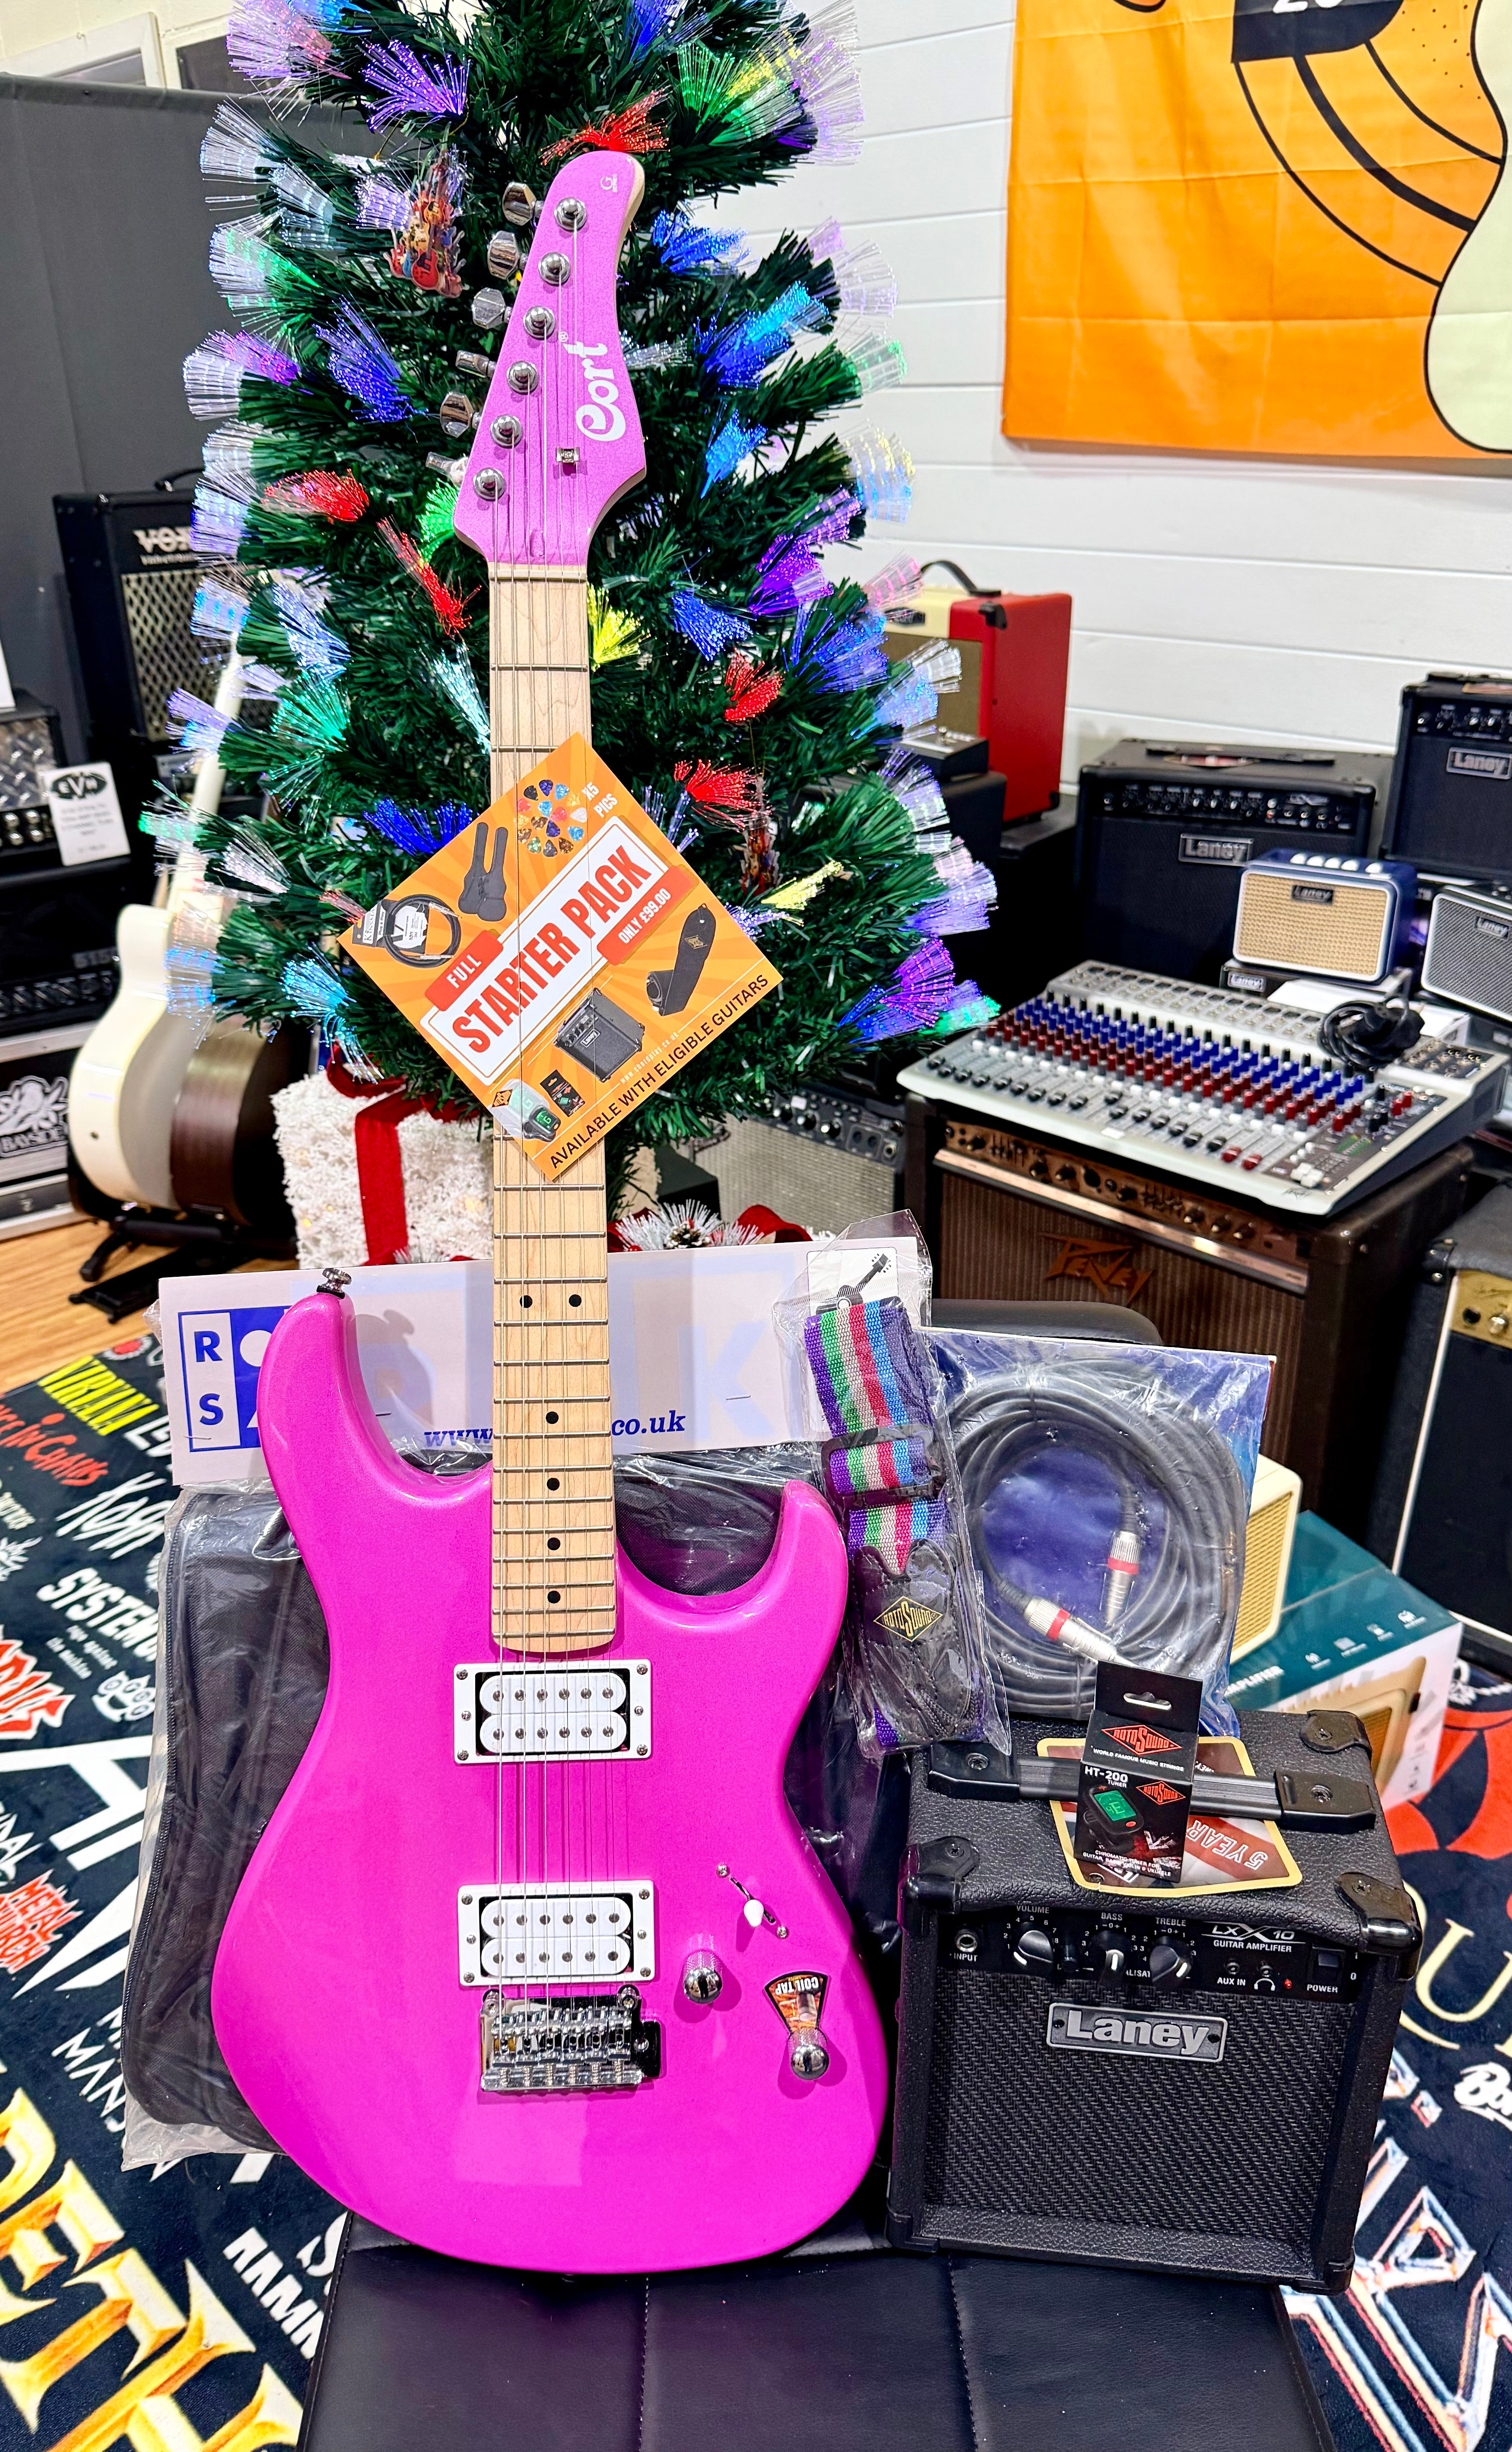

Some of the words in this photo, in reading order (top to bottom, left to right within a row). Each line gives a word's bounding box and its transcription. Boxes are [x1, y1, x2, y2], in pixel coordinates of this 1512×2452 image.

[563, 341, 626, 442] Cort
[593, 793, 618, 818] PICS
[1185, 837, 1246, 863] Laney
[618, 919, 643, 944] ONLY
[638, 888, 671, 924] £99.00
[452, 923, 580, 1053] STARTER
[560, 844, 652, 939] PACK
[446, 954, 482, 989] FULL
[619, 1031, 680, 1084] www.chordplay.co.uk
[550, 1102, 622, 1169] AVAILABLE
[618, 1072, 656, 1107] WITH
[653, 1022, 714, 1077] ELIGIBLE
[711, 974, 768, 1027] GUITARS
[1093, 1748, 1114, 1757] WORLD
[1115, 1753, 1139, 1762] FAMOUS
[1139, 1757, 1158, 1766] MUSIC
[1160, 1762, 1184, 1772] STRINGS
[1084, 1766, 1128, 1783] HT-200
[1107, 1779, 1127, 1788] TUNER
[1185, 1819, 1249, 1864] YEAR
[1083, 1851, 1104, 1863] GUITAR,
[1095, 1849, 1128, 1862] CHROMATIC
[1129, 1857, 1148, 1866] TUNER
[1244, 1851, 1269, 1871] 5
[1016, 1905, 1050, 1914] VOLUME
[1101, 1912, 1123, 1921] BASS
[1155, 1917, 1187, 1927] TREBLE
[1213, 1939, 1244, 1949] GUITAR
[1245, 1942, 1292, 1953] AMPLIFIER
[953, 1952, 978, 1962] INPUT
[775, 1981, 795, 1996] TAP
[795, 1976, 819, 1991] COIL
[1217, 1977, 1235, 1985] AUX
[1237, 1978, 1246, 1986] IN
[1307, 1984, 1339, 1993] POWER
[1065, 2010, 1210, 2056] Laney
